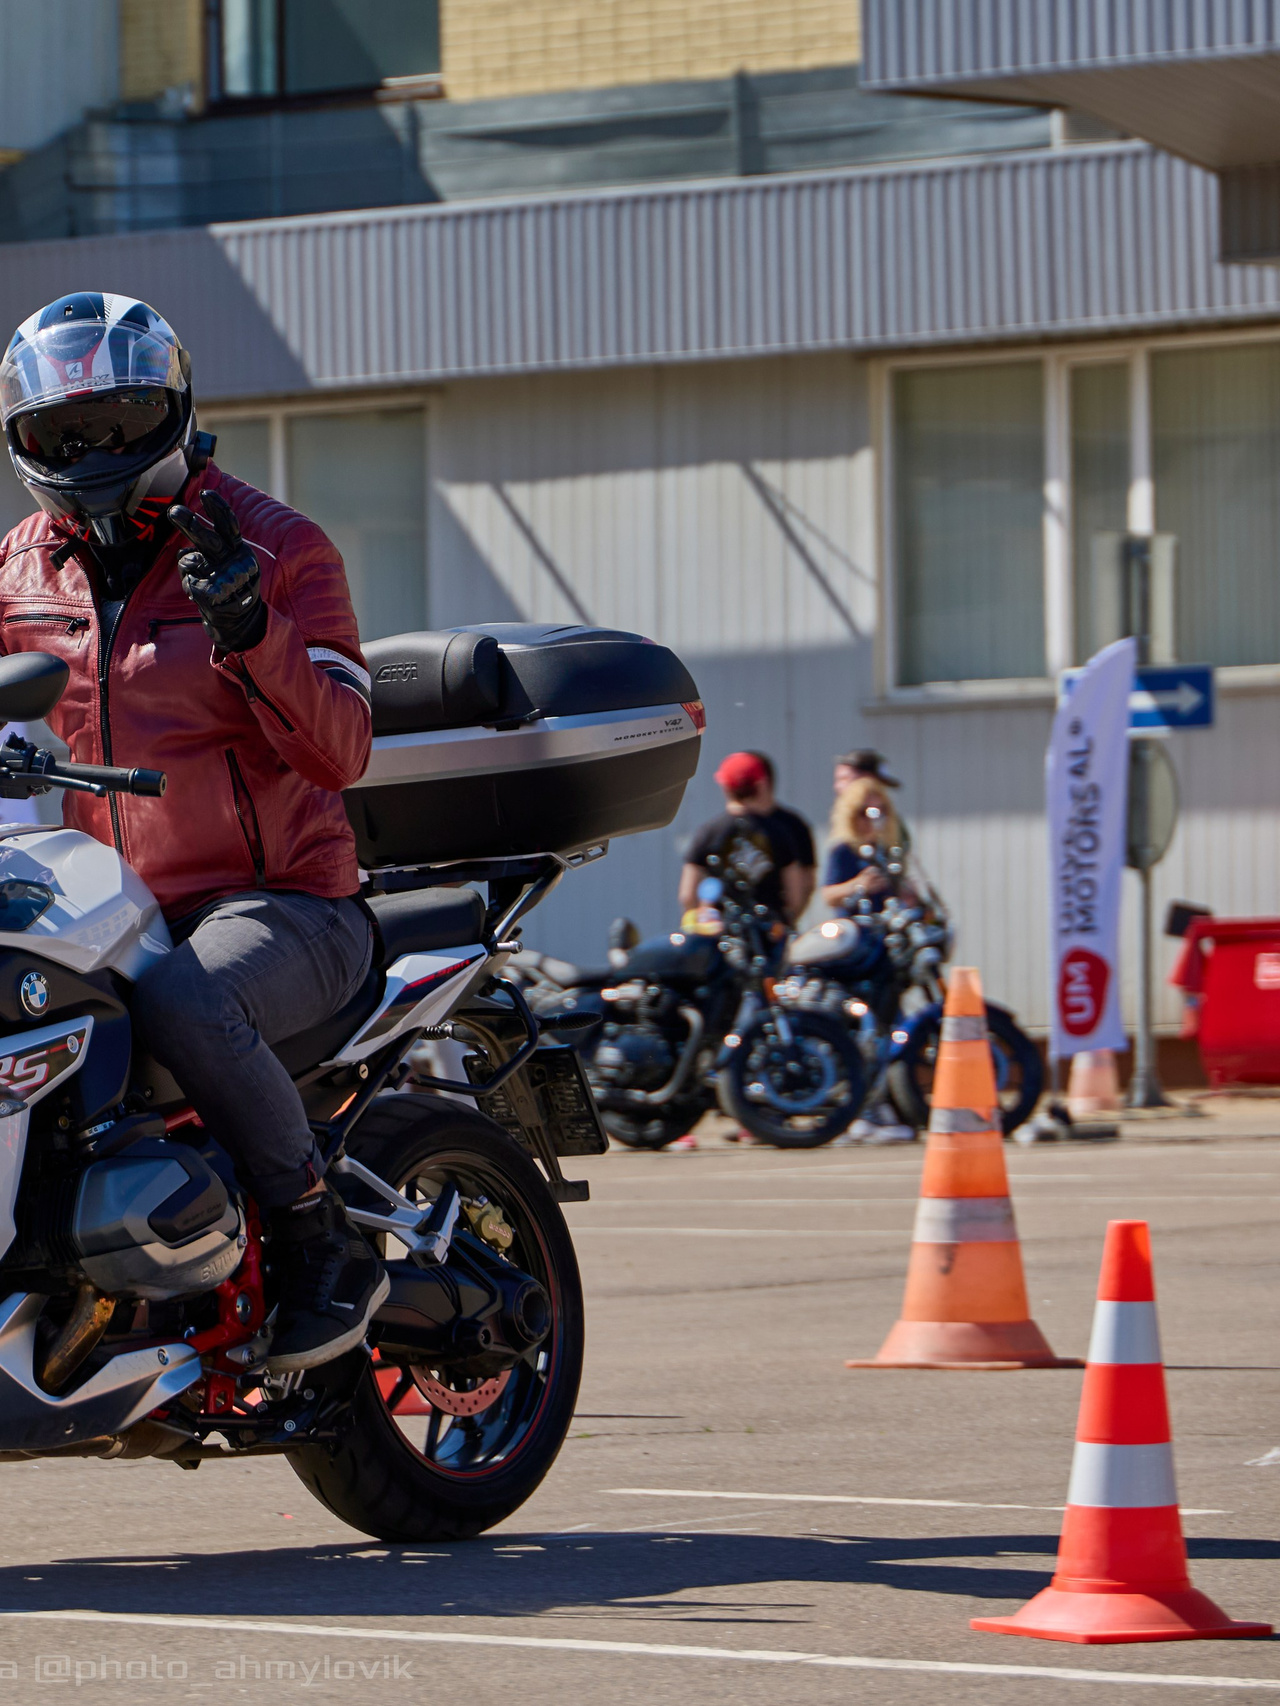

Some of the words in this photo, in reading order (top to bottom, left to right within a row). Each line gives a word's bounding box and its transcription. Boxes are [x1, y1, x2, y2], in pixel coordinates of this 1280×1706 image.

[375, 662, 418, 683] GIVI
[614, 731, 658, 742] MONOKEY
[1065, 960, 1095, 1023] UM
[200, 1248, 235, 1283] BMW
